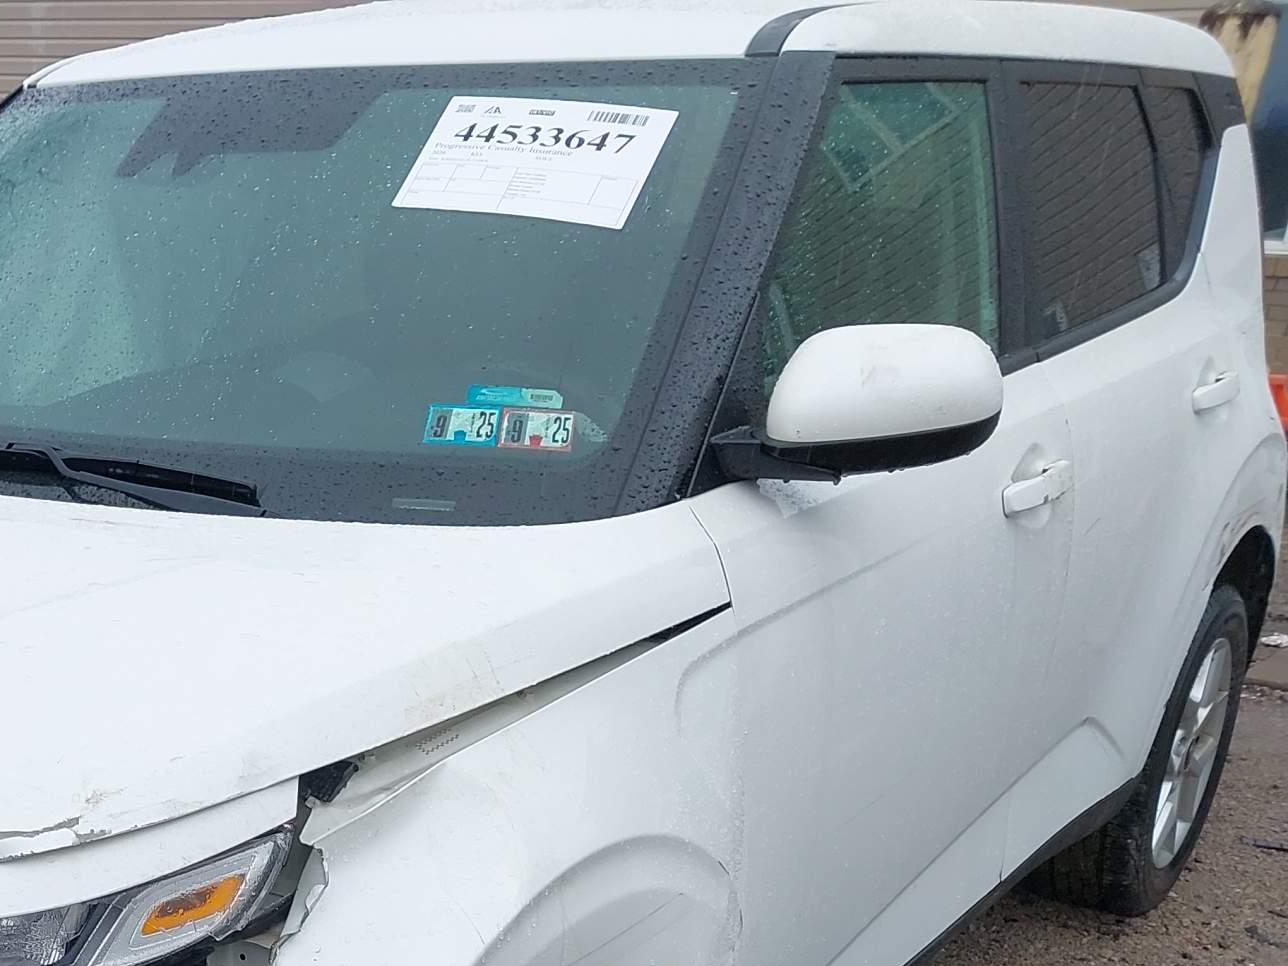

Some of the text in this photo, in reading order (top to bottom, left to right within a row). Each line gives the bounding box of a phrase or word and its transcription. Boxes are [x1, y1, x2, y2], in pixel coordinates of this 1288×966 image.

[434, 141, 574, 157] Progressive Casualty Insurance
[454, 121, 637, 154] 44533647
[433, 414, 447, 438] 9
[475, 411, 497, 439] 25
[511, 419, 524, 443] 9
[552, 416, 572, 444] 25
